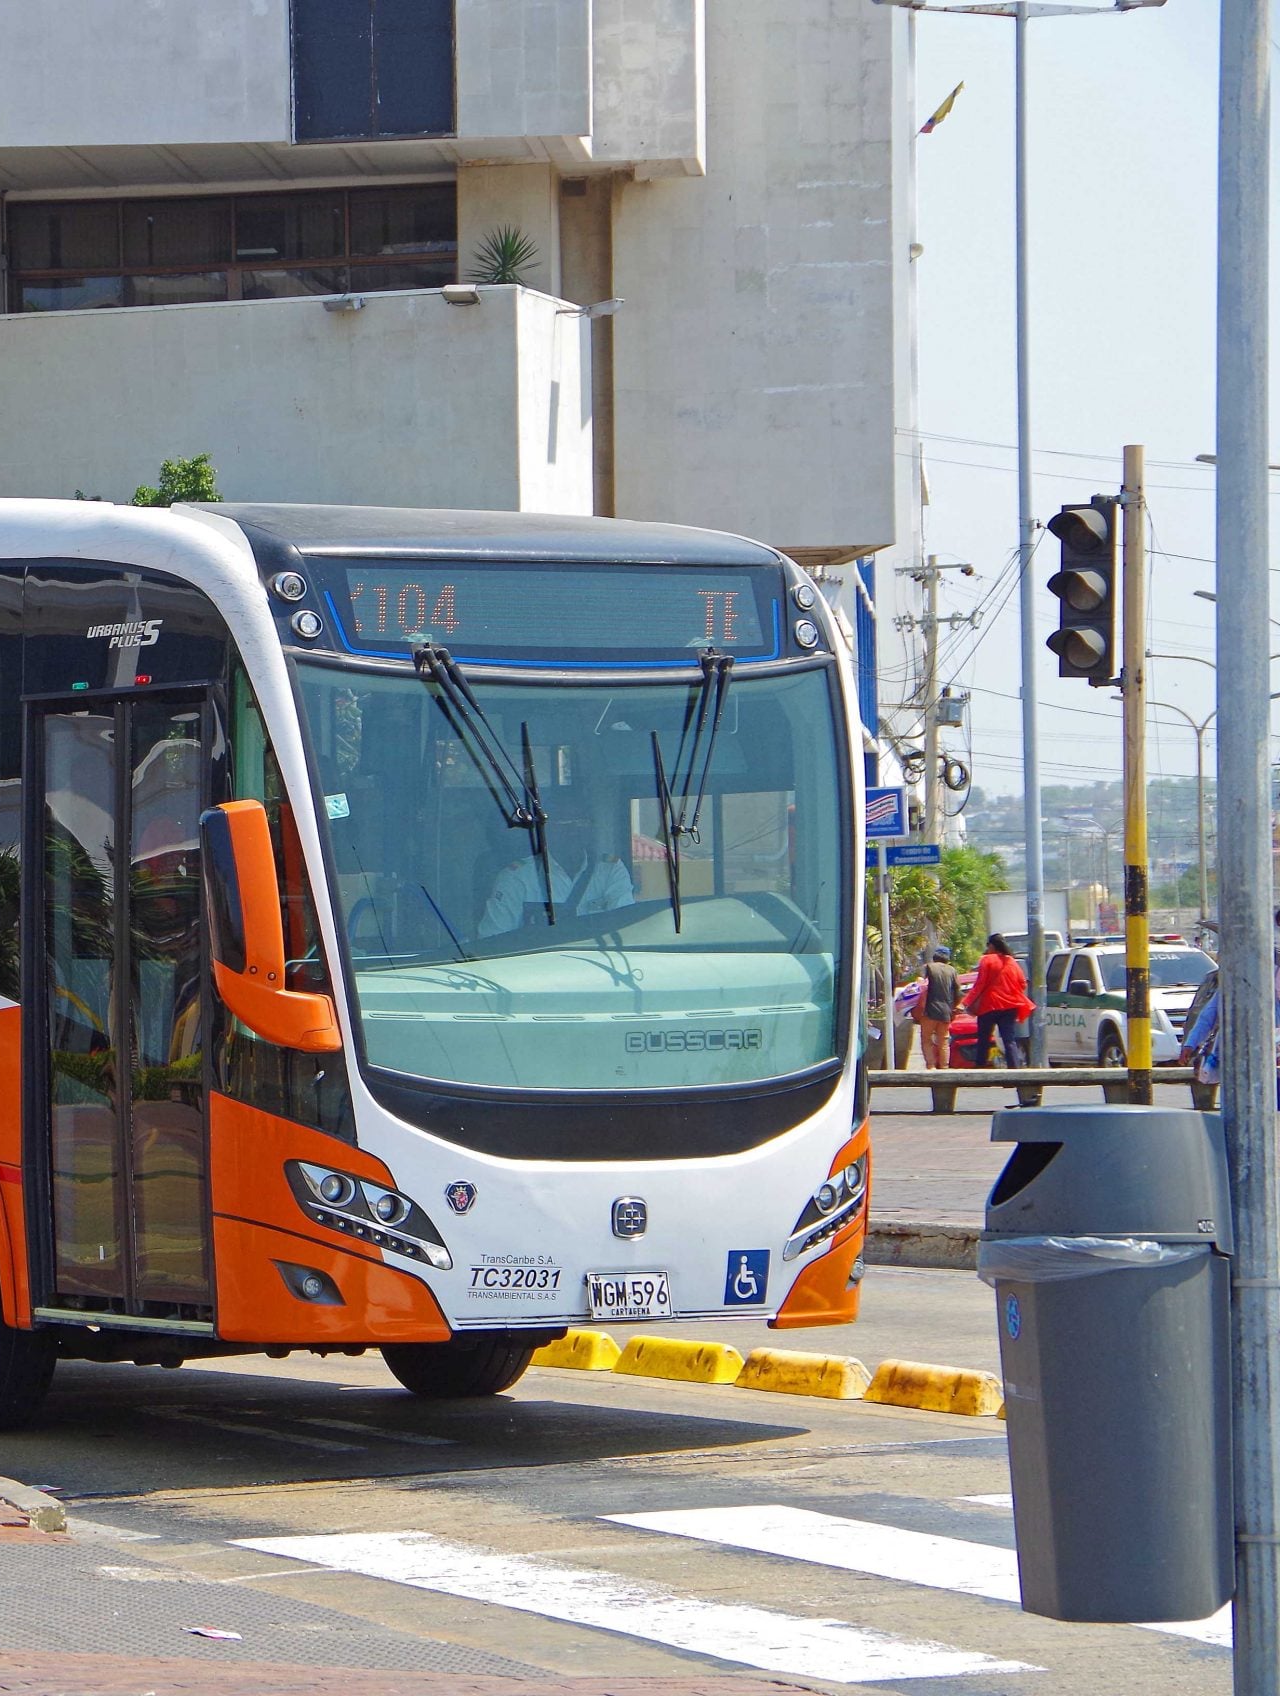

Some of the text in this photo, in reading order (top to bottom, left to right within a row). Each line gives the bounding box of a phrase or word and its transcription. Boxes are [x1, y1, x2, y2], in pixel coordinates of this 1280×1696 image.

[1047, 1012, 1088, 1028] OLICIA
[624, 1028, 763, 1053] BUSSCAR
[480, 1253, 556, 1266] TransCaribe S.A.
[470, 1267, 561, 1289] TC32031
[467, 1290, 536, 1301] TRANSAMBIENTAL
[591, 1280, 668, 1308] WGM 596
[611, 1307, 651, 1317] CARTAGENA
